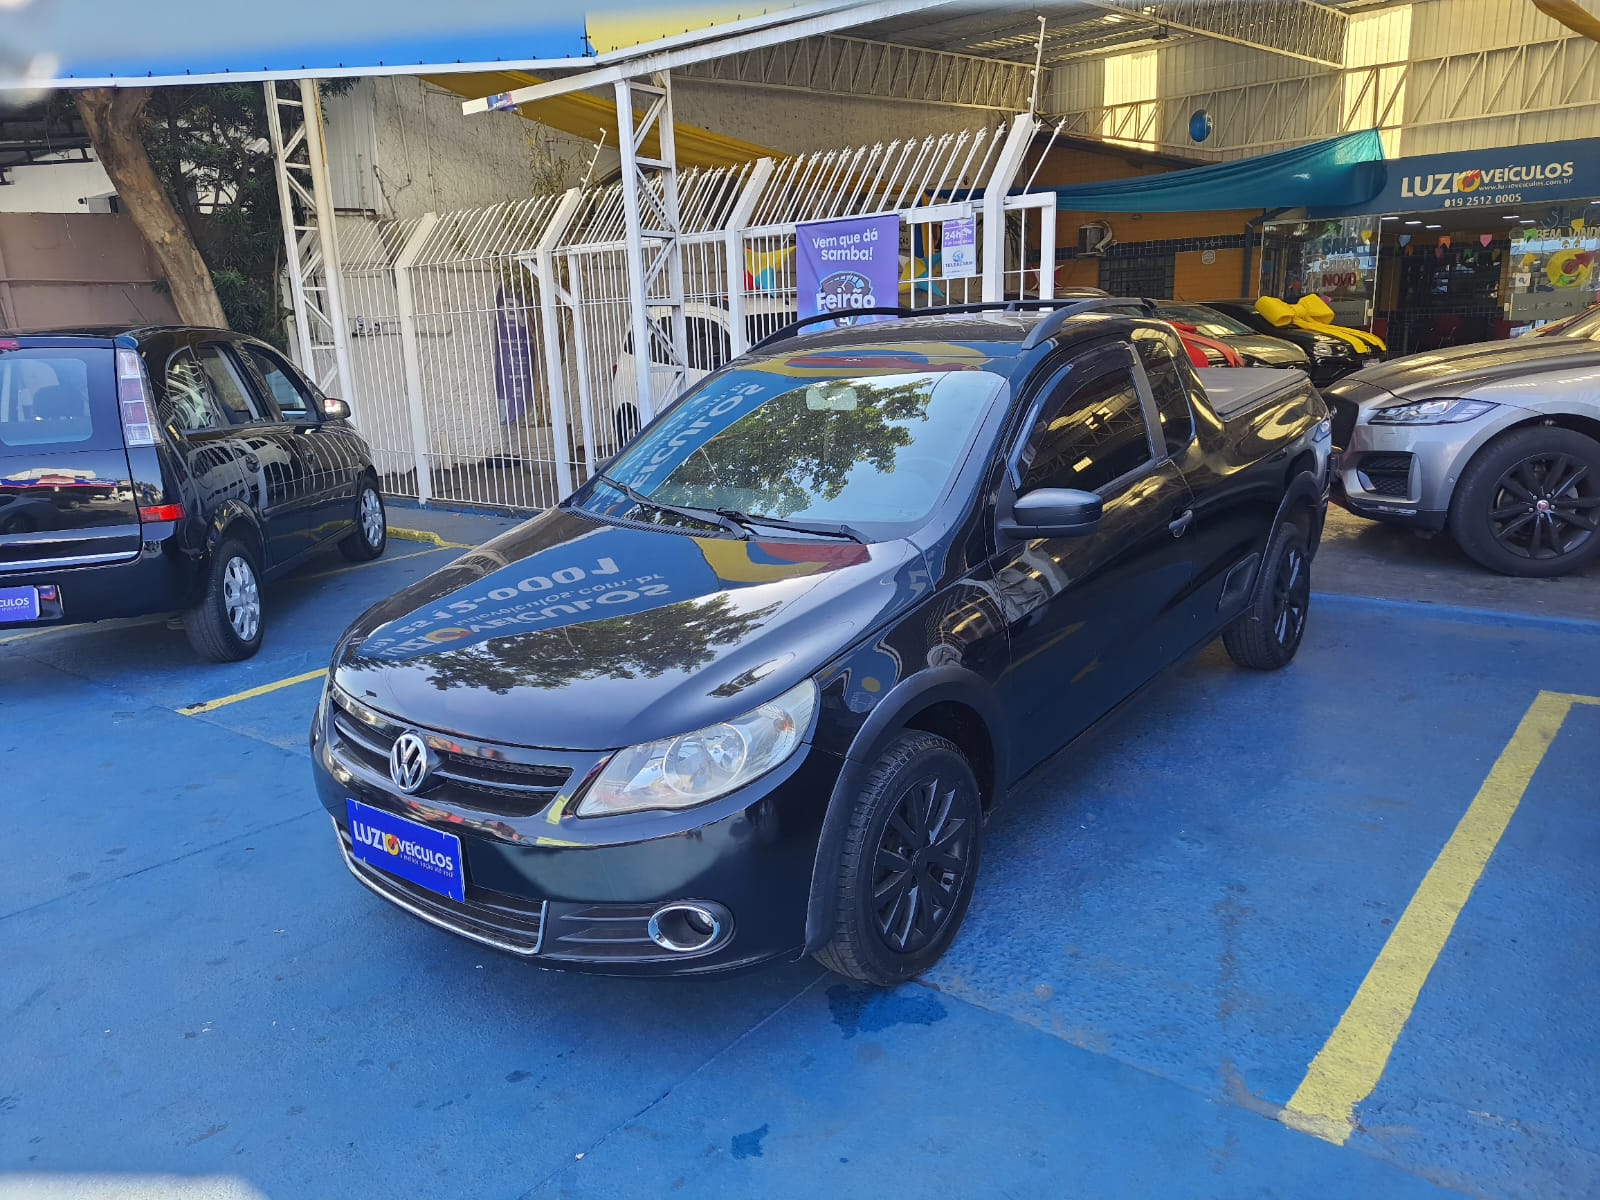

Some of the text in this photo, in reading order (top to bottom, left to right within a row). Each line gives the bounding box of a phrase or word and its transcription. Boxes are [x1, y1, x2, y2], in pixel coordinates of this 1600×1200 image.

[1480, 162, 1574, 184] VEÍCULOS
[1466, 195, 1492, 206] 2512
[1495, 193, 1522, 204] 0005
[812, 227, 878, 249] Vem que dá
[821, 245, 873, 261] samba!
[1322, 271, 1357, 288] NOVO
[816, 287, 876, 311] Feirão
[397, 838, 454, 871] VEÍCULOS
